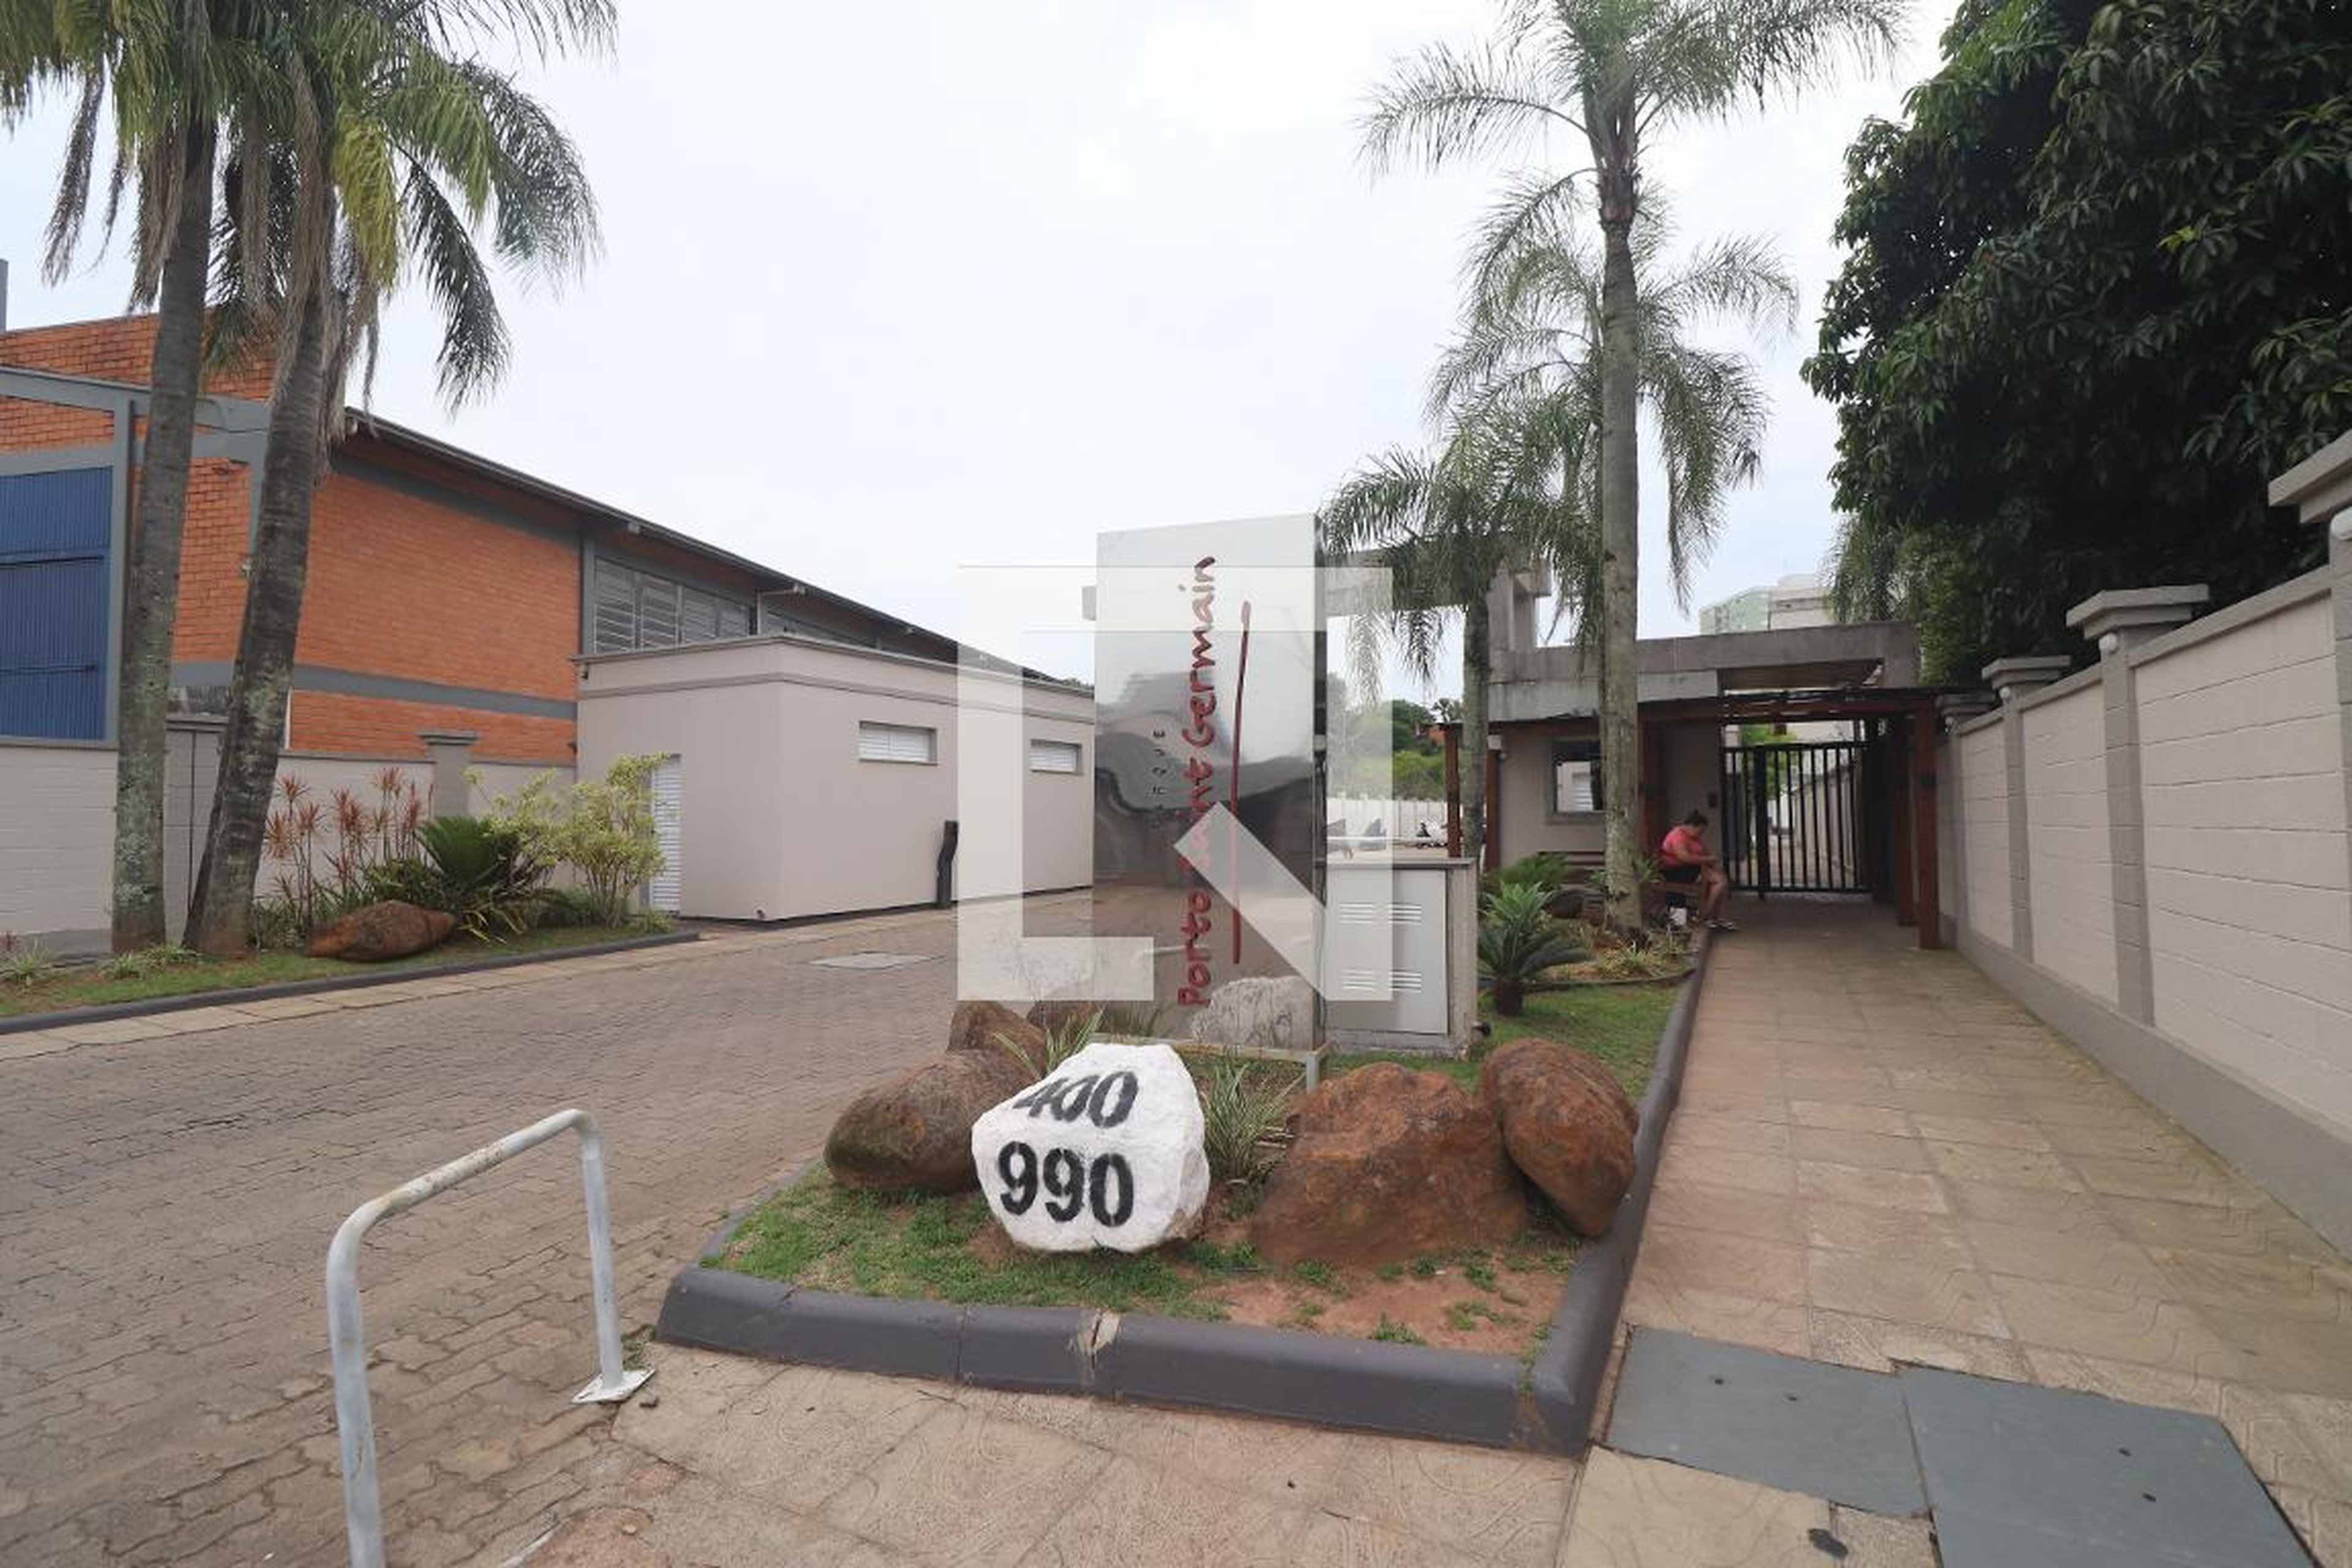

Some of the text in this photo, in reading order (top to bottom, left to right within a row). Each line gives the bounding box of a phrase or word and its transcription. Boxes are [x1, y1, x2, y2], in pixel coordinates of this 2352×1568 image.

[1178, 557, 1216, 747] Germain
[1178, 891, 1211, 1006] Porto
[1014, 1071, 1139, 1128] 400
[998, 1142, 1134, 1227] 990
